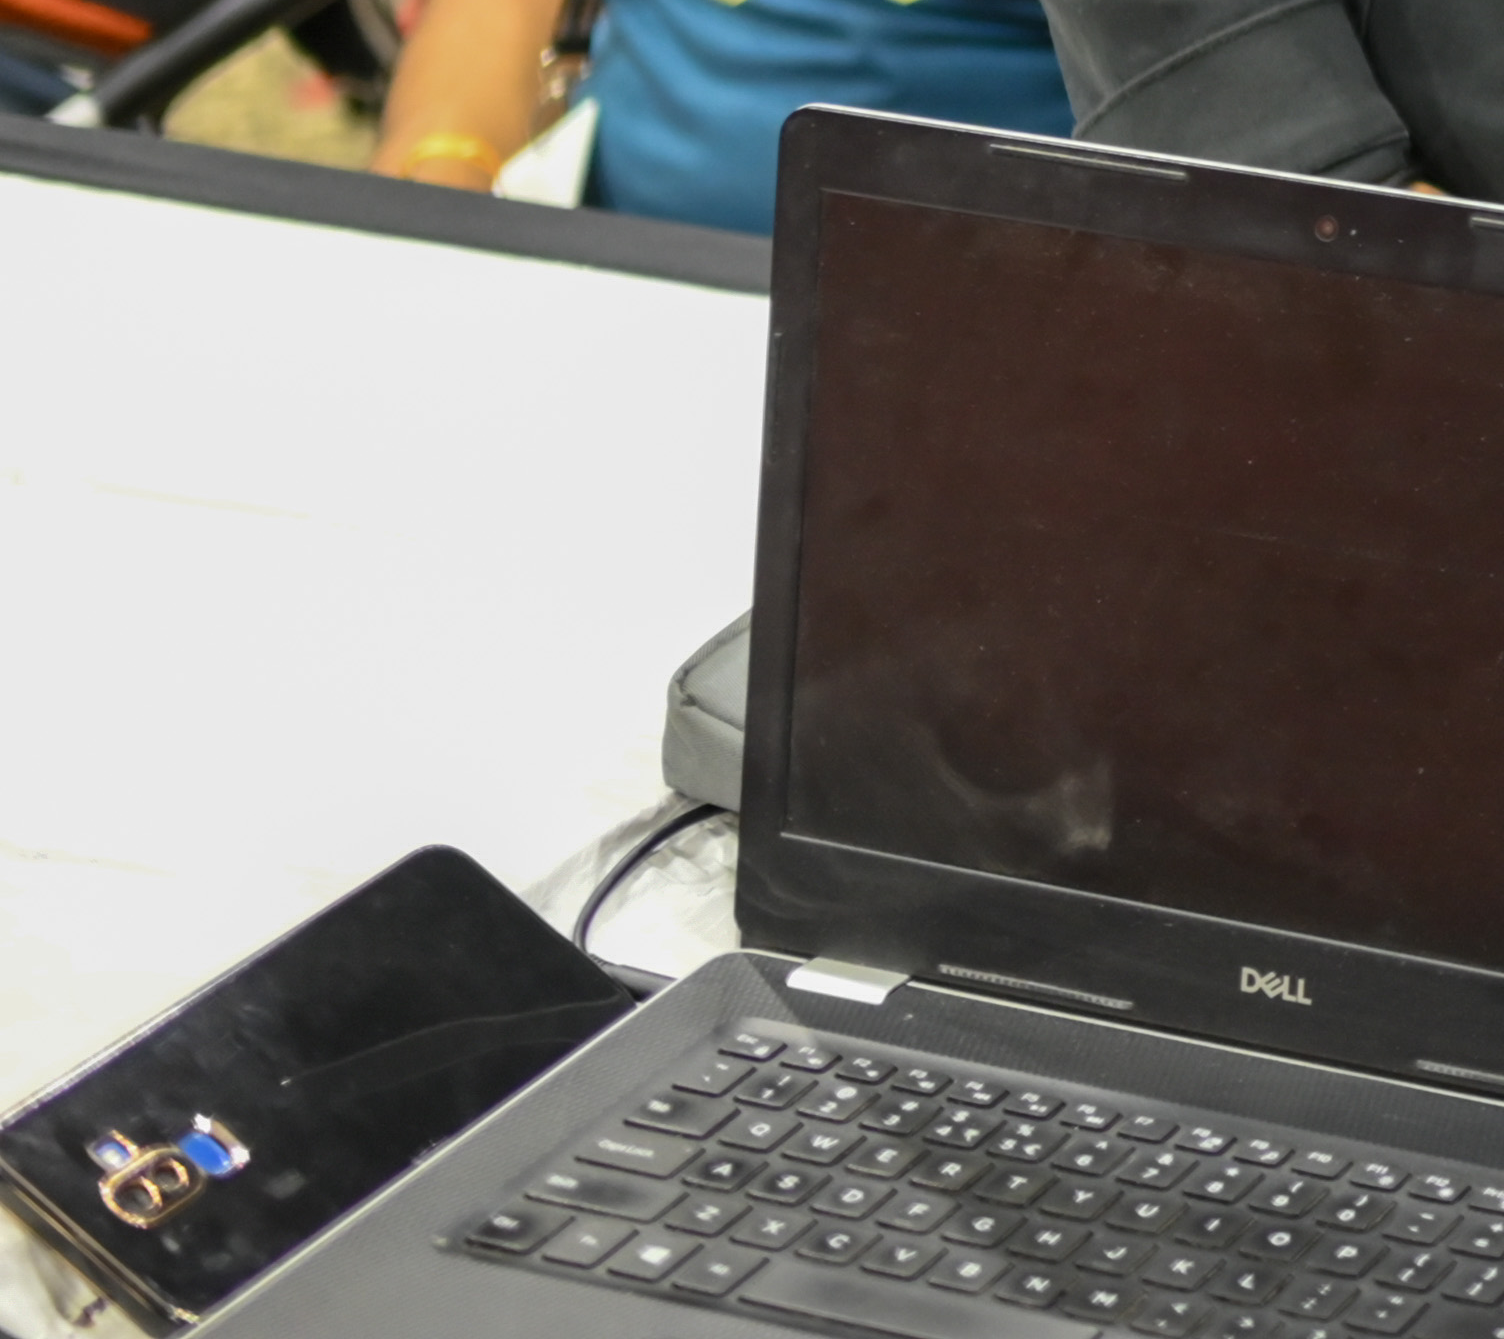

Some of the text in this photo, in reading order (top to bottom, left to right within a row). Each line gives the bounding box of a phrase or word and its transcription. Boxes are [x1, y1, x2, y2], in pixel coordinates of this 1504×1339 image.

[1240, 966, 1312, 1006] DELL
[749, 1123, 771, 1137] Q
[811, 1135, 839, 1150] W
[876, 1148, 898, 1163] E
[711, 1163, 734, 1176] A
[940, 1162, 962, 1176] R
[776, 1175, 800, 1190] S
[1008, 1176, 1028, 1190] T
[841, 1188, 864, 1204] D
[1073, 1189, 1094, 1204] Y
[695, 1205, 721, 1221] Z
[907, 1202, 930, 1217] F
[1135, 1203, 1160, 1218] U
[762, 1219, 785, 1235] X
[972, 1217, 995, 1232] G
[827, 1233, 850, 1248] C
[1036, 1230, 1062, 1246] H
[1268, 1231, 1292, 1247] O
[895, 1247, 917, 1263] V
[1104, 1246, 1128, 1261] J
[1336, 1245, 1358, 1259] P
[1170, 1258, 1196, 1274] K
[1026, 1276, 1050, 1292] N
[1090, 1289, 1119, 1307] M
